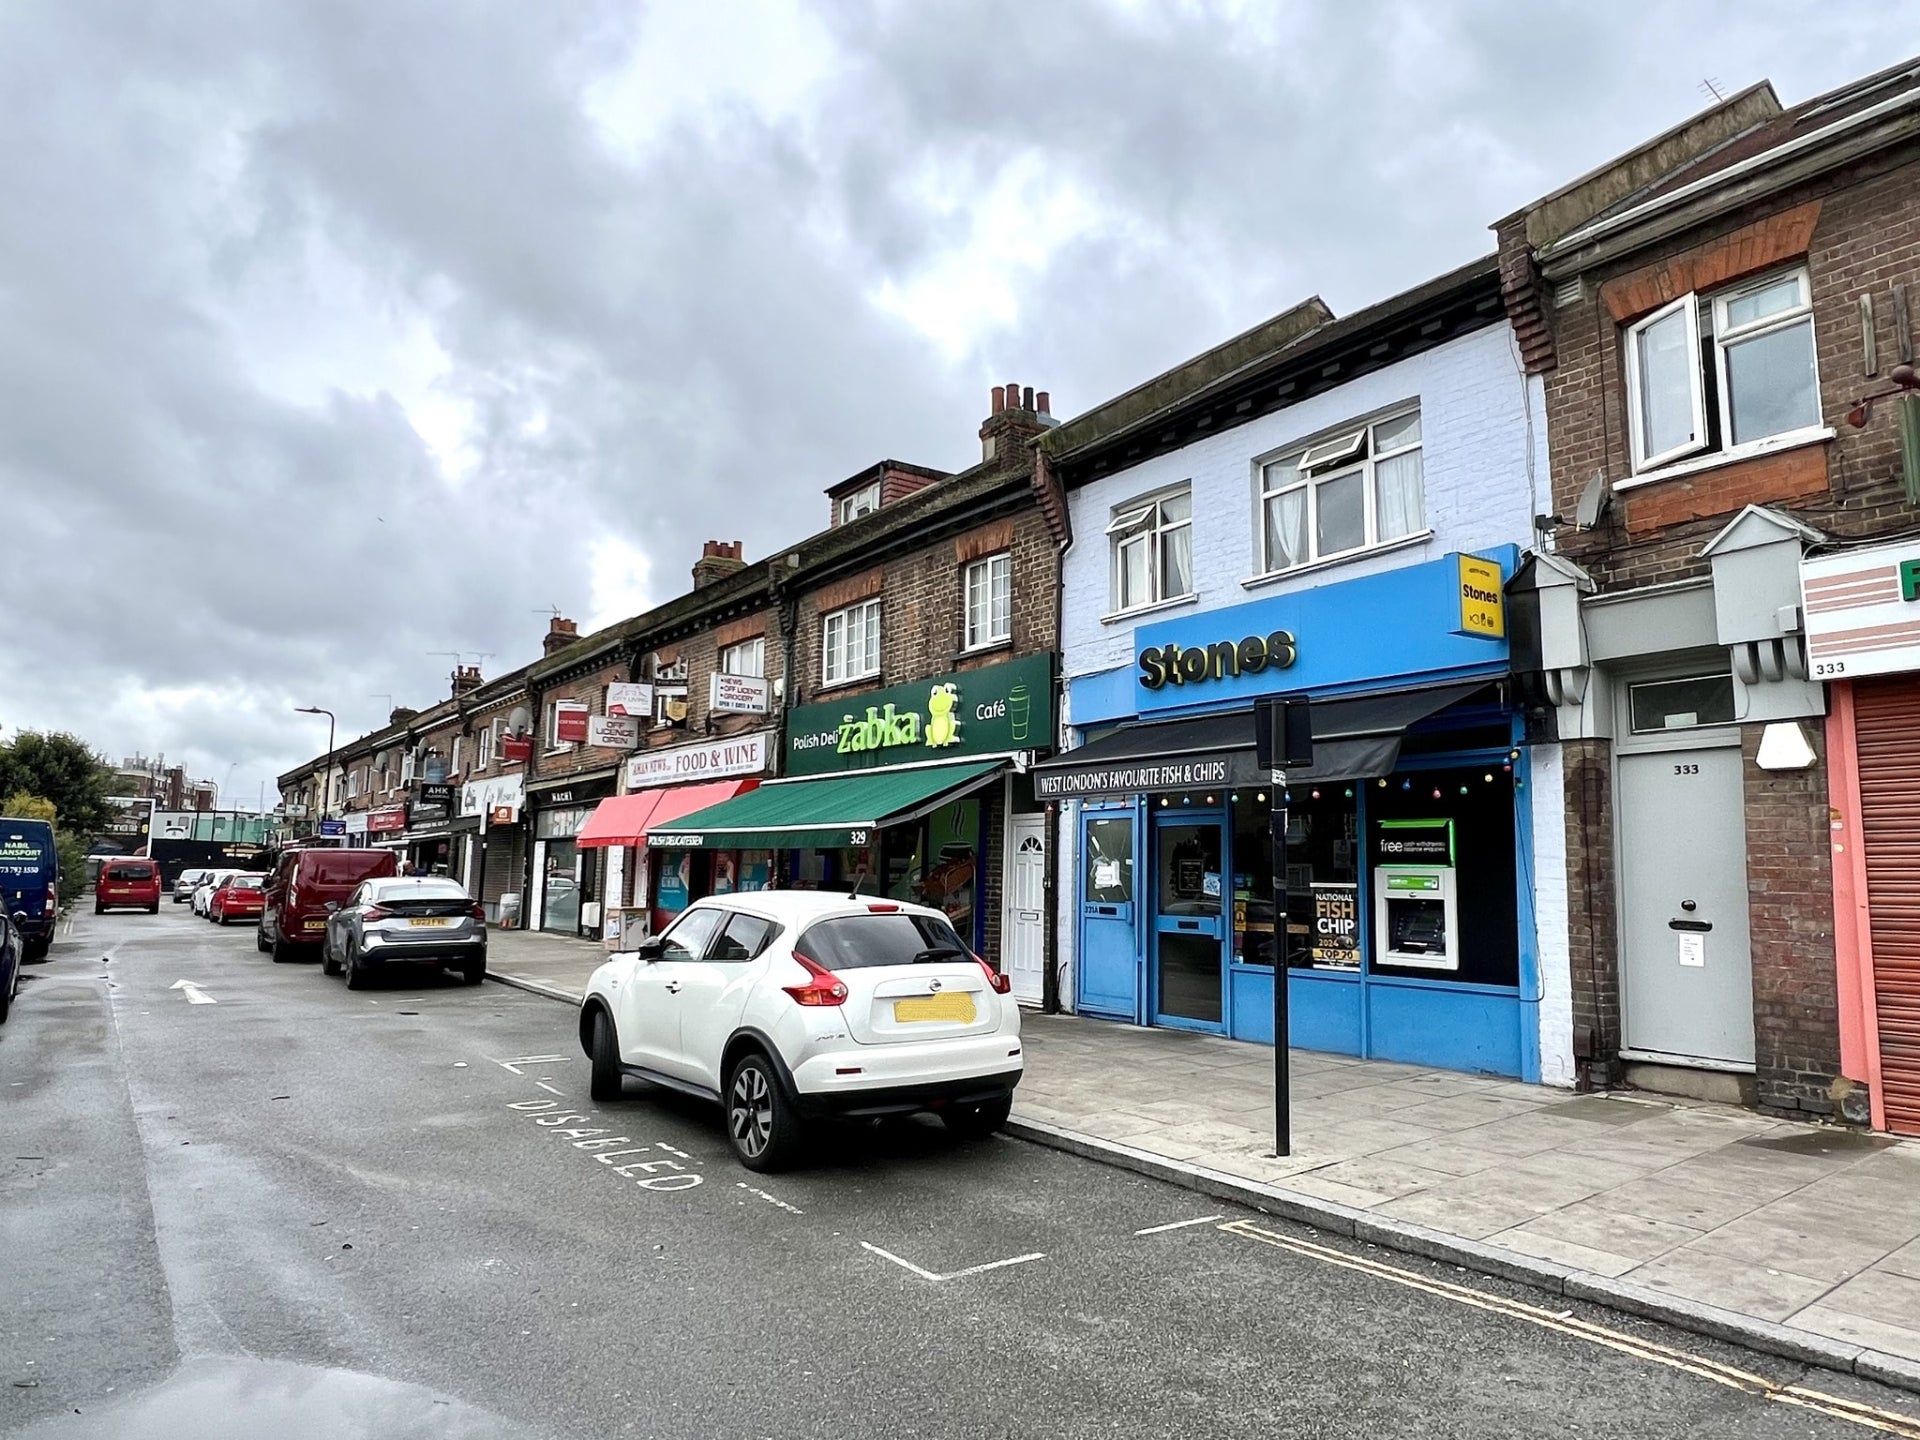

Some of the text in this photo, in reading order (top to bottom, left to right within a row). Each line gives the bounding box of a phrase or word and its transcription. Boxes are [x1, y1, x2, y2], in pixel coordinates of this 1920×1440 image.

[1463, 584, 1498, 604] Stones
[1139, 630, 1296, 689] Stones
[1816, 662, 1845, 675] 333
[724, 678, 742, 686] NEWS
[724, 693, 753, 702] GROCERY
[737, 687, 763, 695] LICENCE
[976, 699, 1006, 721] Café
[607, 721, 625, 729] OFF
[596, 727, 634, 738] LICENCE
[602, 736, 628, 744] OPEN
[793, 729, 839, 750] Polish Deli
[676, 752, 706, 772] FOOD
[710, 750, 720, 768] &
[724, 743, 758, 765] WINE
[1674, 764, 1699, 775] 333
[1041, 761, 1225, 793] WEST LONDON'S FAVOURITE FISH & CHIPS
[850, 831, 866, 845] 329
[1380, 839, 1403, 853] free
[1315, 893, 1354, 902] NATIONAL
[1316, 901, 1355, 919] FISH
[1317, 918, 1355, 934] CHIP
[1318, 938, 1339, 947] 2024
[1320, 950, 1339, 960] TOP
[506, 1099, 704, 1191] DISABLED
